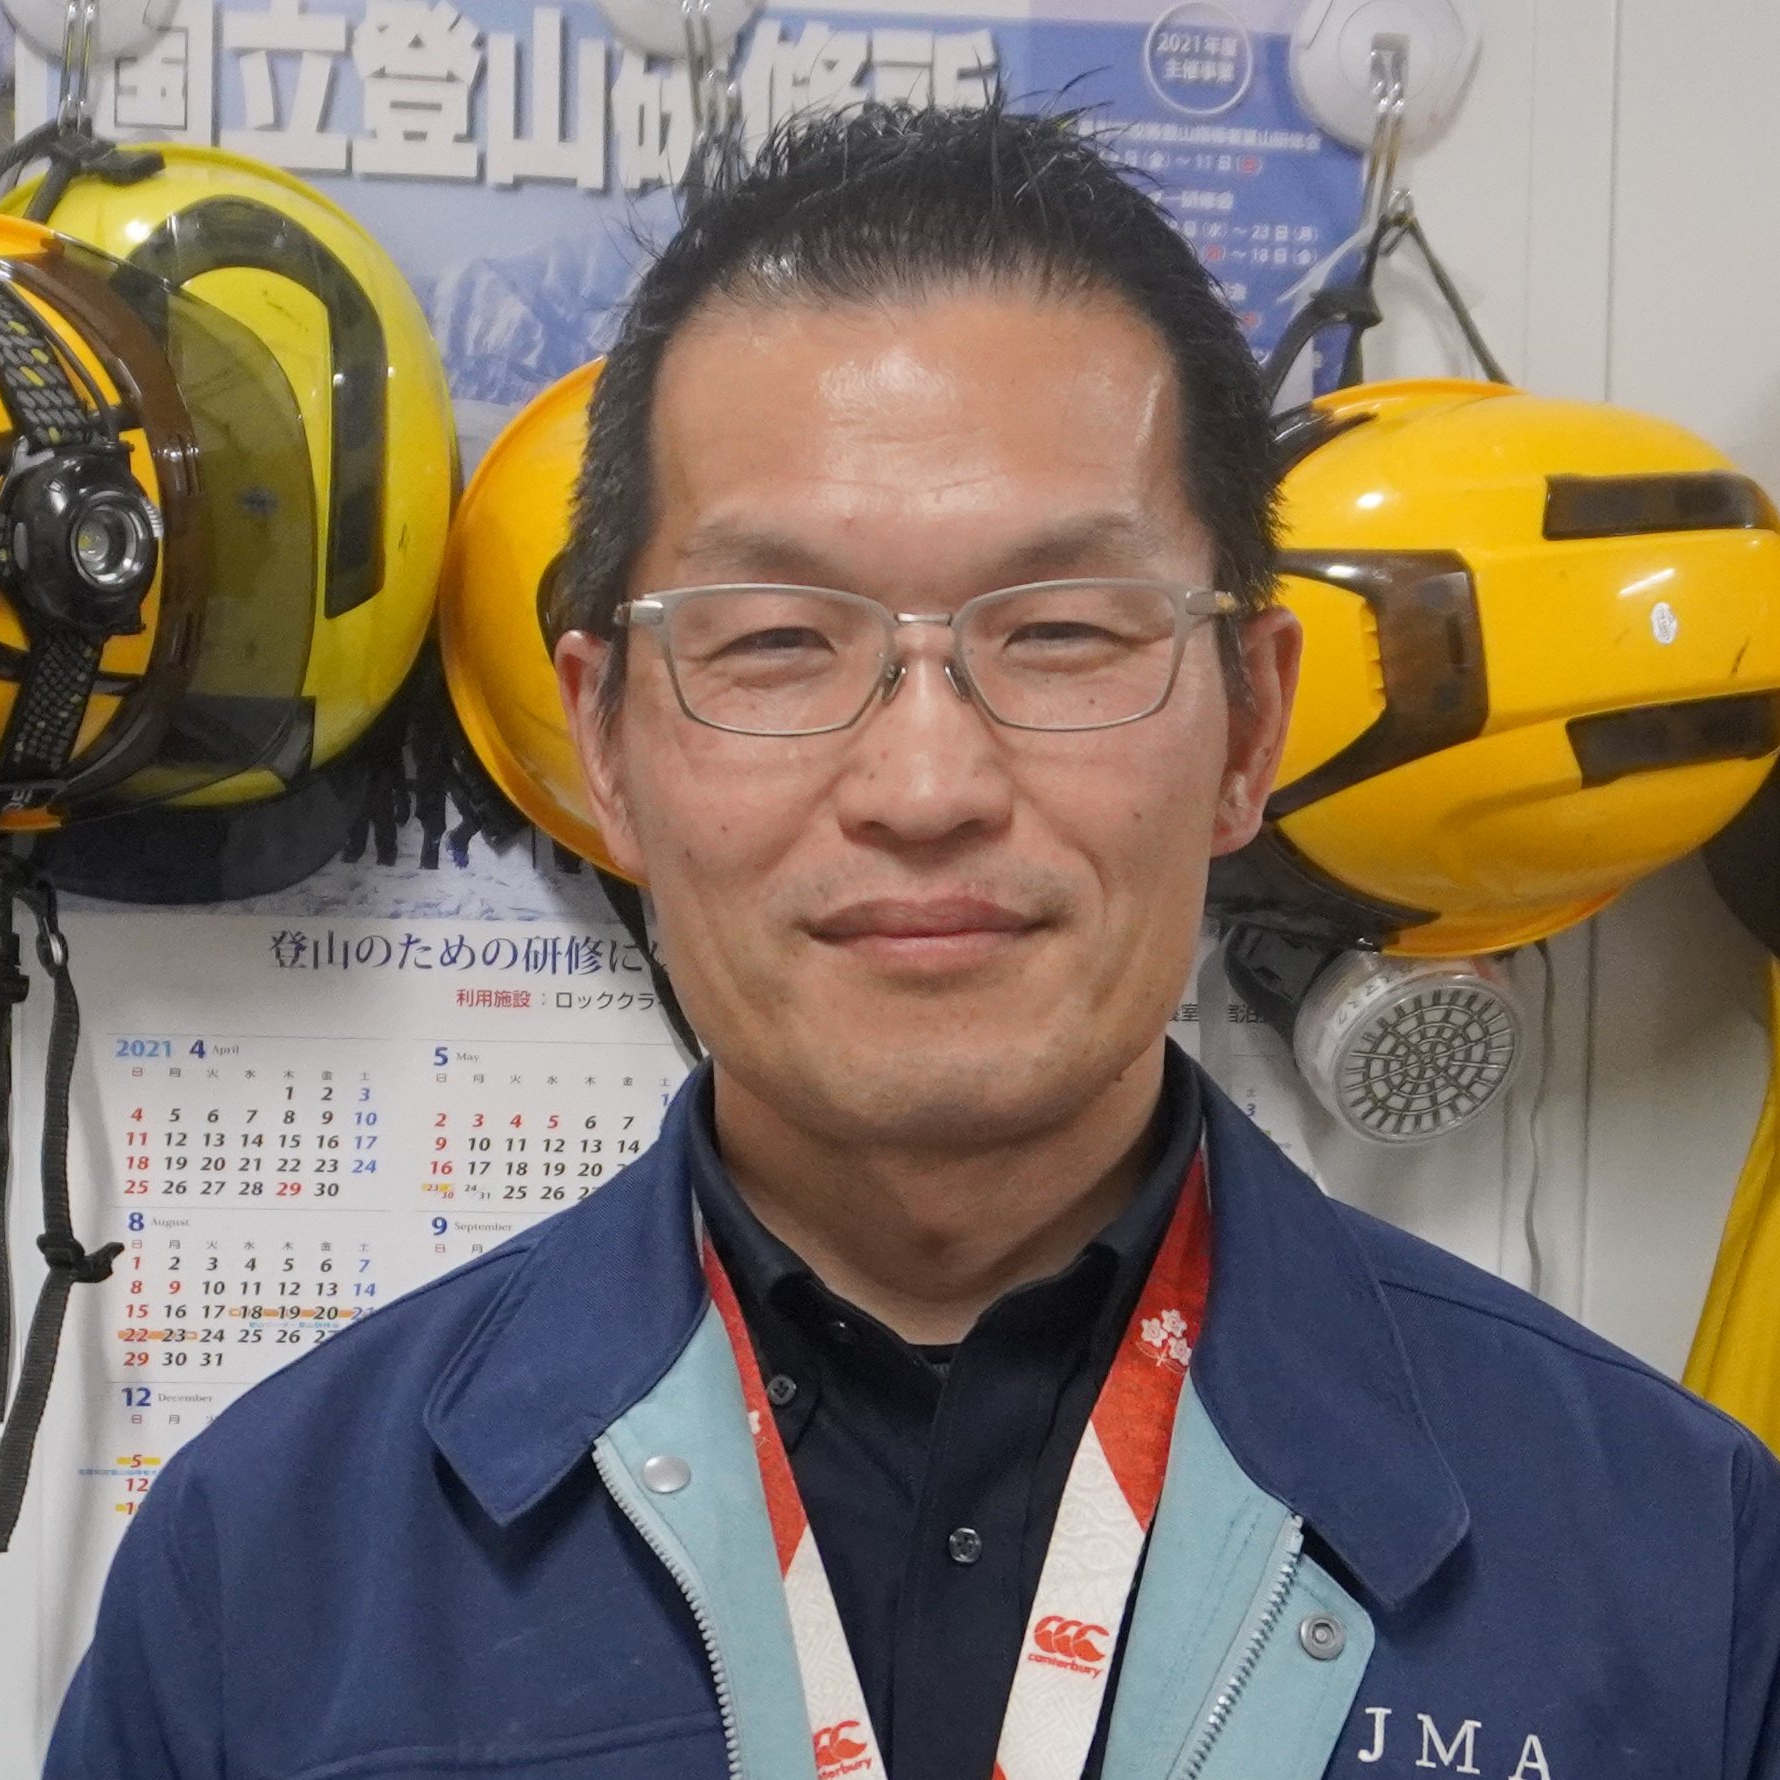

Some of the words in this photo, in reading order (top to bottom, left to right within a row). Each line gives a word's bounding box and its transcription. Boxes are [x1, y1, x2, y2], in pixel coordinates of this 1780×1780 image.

[116, 1039, 172, 1058] 2021
[189, 1039, 206, 1059] 4
[212, 1044, 240, 1057] April
[434, 1046, 449, 1067] 5
[456, 1052, 480, 1063] May
[285, 1086, 294, 1101] 1
[321, 1086, 334, 1102] 2
[359, 1087, 371, 1102] 3
[130, 1107, 143, 1122] 4
[169, 1107, 181, 1123] 5
[207, 1108, 220, 1124] 6
[246, 1109, 258, 1124] 7
[282, 1109, 296, 1125] 8
[321, 1110, 334, 1125] 9
[355, 1111, 378, 1127] 10
[434, 1112, 448, 1128] 2
[472, 1113, 485, 1128] 3
[509, 1114, 522, 1129] 4
[547, 1114, 559, 1130] 5
[584, 1115, 597, 1130] 6
[623, 1116, 635, 1130] 7
[126, 1131, 148, 1146] 11
[165, 1132, 188, 1147] 12
[204, 1132, 226, 1148] 13
[241, 1133, 264, 1148] 14
[279, 1134, 301, 1149] 15
[317, 1134, 340, 1150] 16
[355, 1135, 378, 1150] 17
[435, 1136, 448, 1151] 9
[469, 1137, 492, 1152] 10
[506, 1137, 527, 1152] 11
[543, 1138, 566, 1153] 12
[581, 1139, 603, 1154] 13
[618, 1139, 640, 1154] 14
[127, 1155, 150, 1171] 18
[165, 1156, 188, 1171] 19
[200, 1156, 227, 1172] 20
[238, 1157, 262, 1172] 21
[276, 1157, 302, 1173] 22
[314, 1158, 339, 1173] 23
[351, 1159, 377, 1174] 24
[431, 1160, 453, 1176] 16
[468, 1161, 491, 1176] 17
[506, 1161, 529, 1177] 18
[543, 1162, 567, 1177] 19
[577, 1162, 604, 1177] 20
[123, 1179, 149, 1195] 25
[162, 1180, 188, 1195] 26
[200, 1180, 227, 1196] 27
[238, 1181, 264, 1196] 28
[276, 1181, 302, 1197] 29
[314, 1182, 340, 1197] 30
[502, 1185, 528, 1200] 25
[540, 1185, 566, 1201] 26
[128, 1211, 145, 1232] 8
[151, 1217, 190, 1229] August
[431, 1216, 448, 1236] 9
[454, 1221, 514, 1233] September
[133, 1256, 141, 1271] 1
[168, 1256, 181, 1271] 2
[206, 1256, 219, 1272] 3
[244, 1257, 257, 1272] 4
[282, 1257, 295, 1273] 5
[320, 1258, 333, 1273] 6
[358, 1258, 371, 1273] 7
[130, 1280, 143, 1295] 8
[169, 1280, 182, 1295] 9
[203, 1280, 226, 1296] 10
[241, 1281, 262, 1296] 11
[279, 1281, 301, 1296] 12
[317, 1282, 339, 1297] 13
[354, 1282, 376, 1297] 14
[126, 1303, 149, 1319] 15
[164, 1304, 187, 1319] 16
[202, 1304, 226, 1319] 17
[241, 1305, 266, 1320] 18
[279, 1305, 304, 1320] 19
[311, 1305, 342, 1321] 20
[122, 1327, 150, 1343] 22
[159, 1328, 190, 1343] 23
[199, 1328, 225, 1343] 24
[237, 1328, 263, 1344] 25
[275, 1329, 301, 1344] 26
[123, 1351, 150, 1367] 29
[162, 1351, 188, 1367] 30
[200, 1352, 223, 1367] 31
[121, 1386, 151, 1407] 12
[157, 1392, 214, 1403] December
[130, 1454, 143, 1468] 5
[126, 1477, 151, 1494] 12
[1027, 1651, 1103, 1679] canterbury
